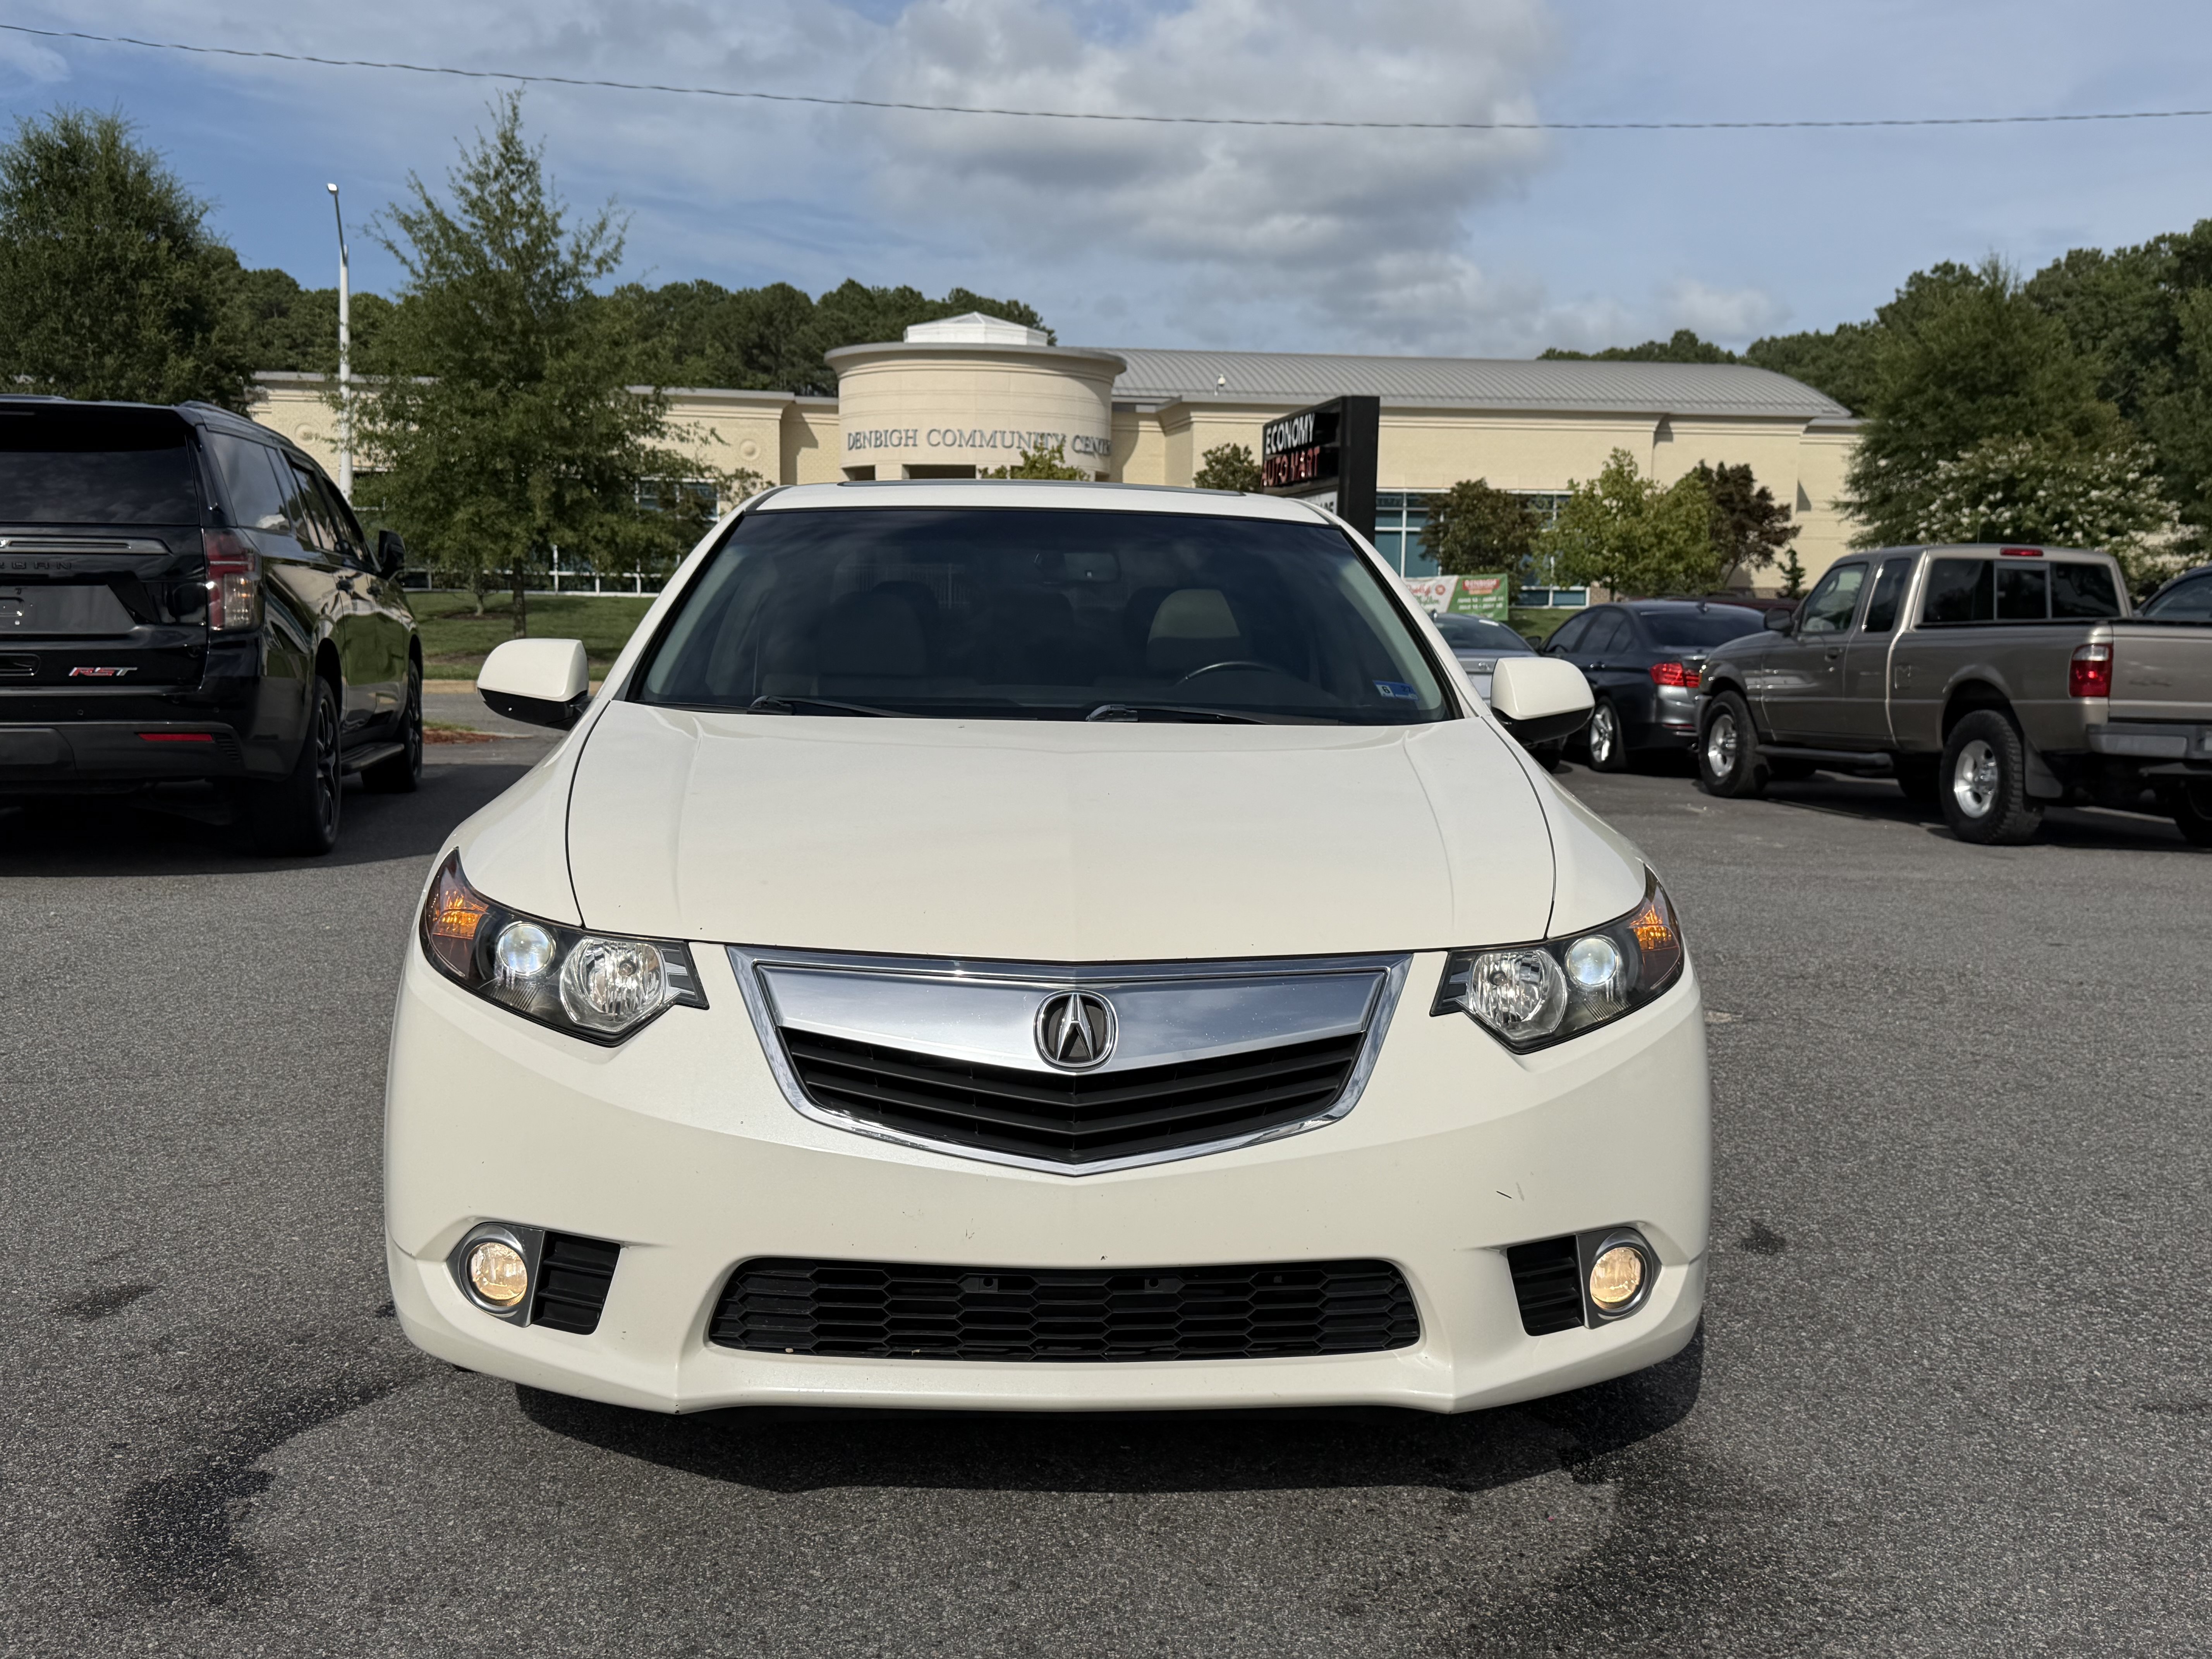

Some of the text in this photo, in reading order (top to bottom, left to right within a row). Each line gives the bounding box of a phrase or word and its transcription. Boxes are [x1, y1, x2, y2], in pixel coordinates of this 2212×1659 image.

[848, 429, 918, 450] DENBIGH
[927, 429, 1066, 450] COMMUNITY
[1265, 412, 1315, 455] ECONOMY
[1261, 454, 1288, 487] AUTO
[69, 667, 138, 677] RST
